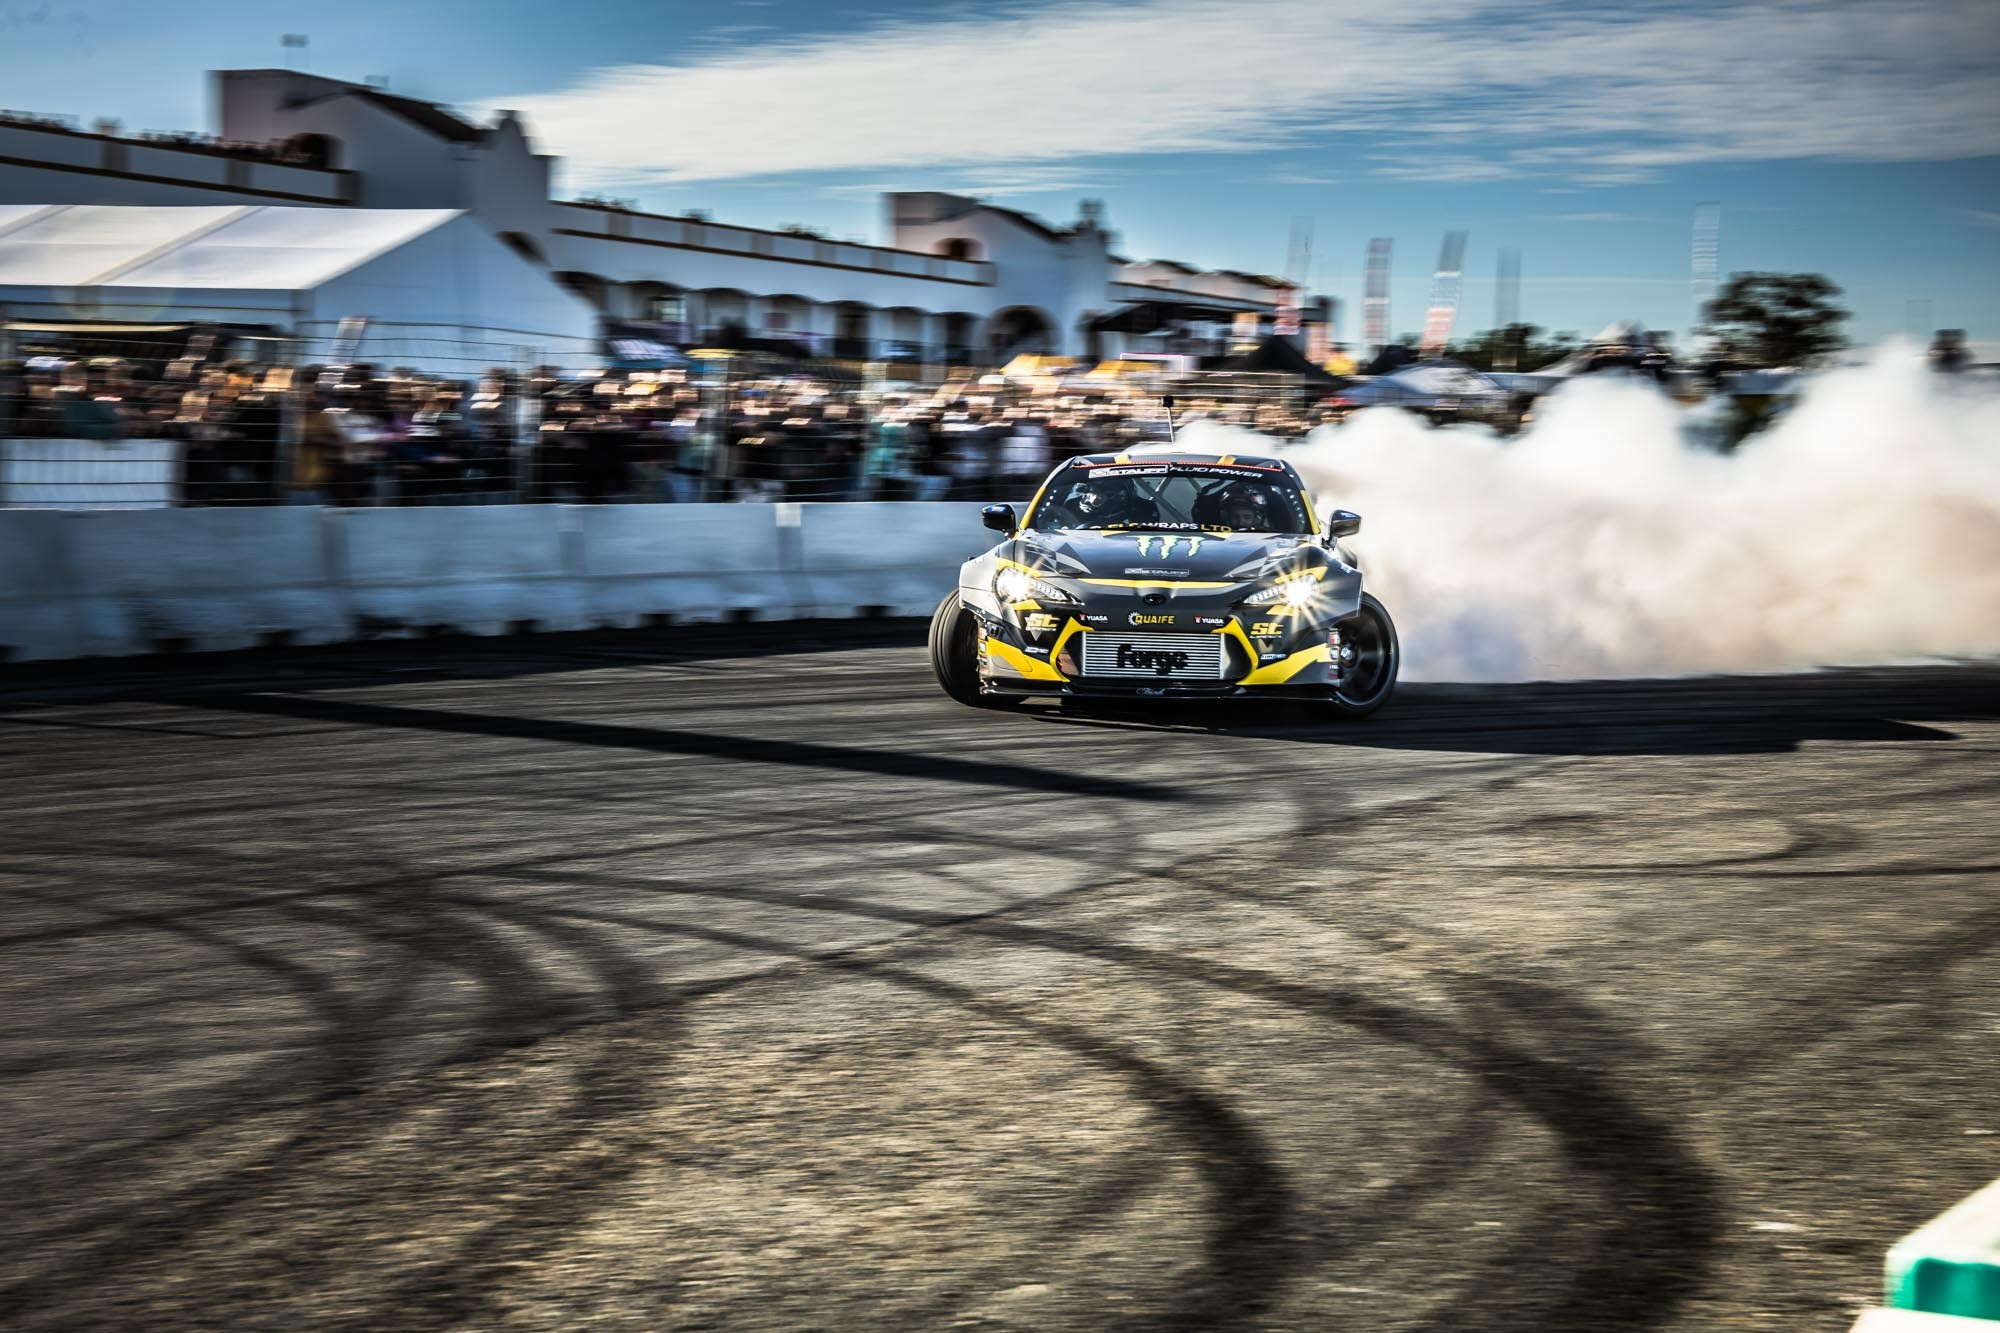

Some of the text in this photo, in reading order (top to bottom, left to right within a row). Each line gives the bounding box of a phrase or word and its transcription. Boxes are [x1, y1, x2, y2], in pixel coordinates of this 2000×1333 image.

[1169, 465, 1209, 473] FLUID
[1209, 468, 1264, 478] POWER
[1200, 523, 1233, 532] LTD
[1134, 614, 1175, 625] QUAIFE
[1116, 643, 1189, 676] Forge
